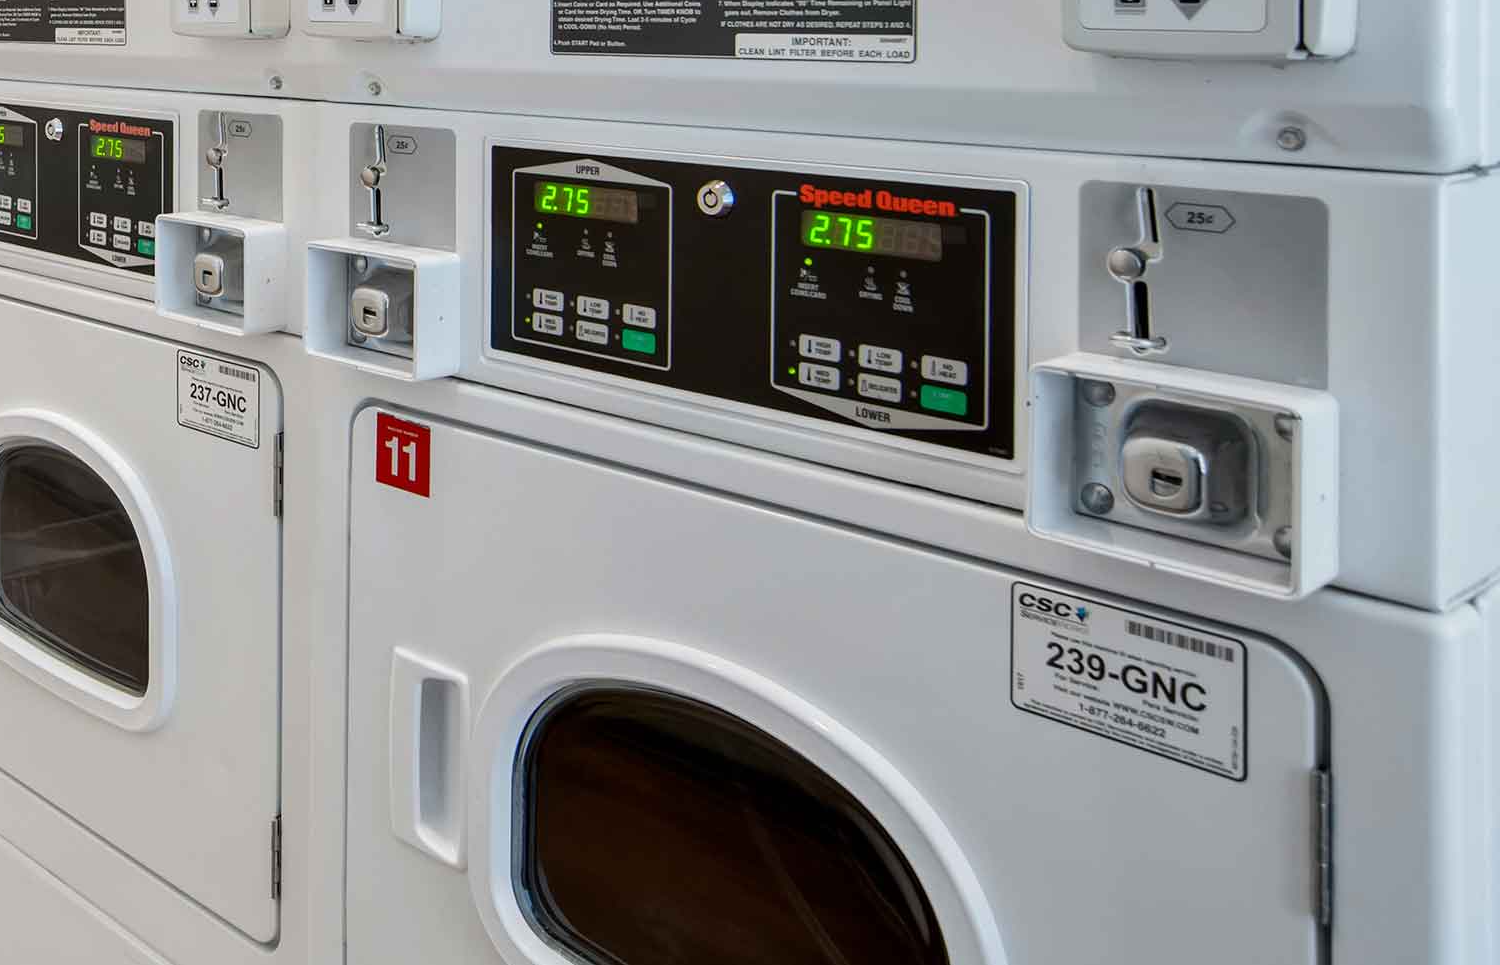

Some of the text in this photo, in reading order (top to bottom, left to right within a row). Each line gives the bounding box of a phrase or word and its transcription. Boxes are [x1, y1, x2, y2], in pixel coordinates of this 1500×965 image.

[792, 37, 851, 46] IMPORTANT:
[739, 48, 764, 56] CLEAN
[768, 48, 786, 56] LINT
[821, 49, 854, 57] BEFORE
[859, 50, 882, 58] EACH
[886, 50, 910, 58] LOAD
[89, 119, 151, 137] Speed Queen
[96, 138, 123, 158] 2.75
[575, 165, 600, 176] UPPER
[541, 185, 589, 214] 2.75
[799, 184, 956, 217] Speed Queen
[809, 214, 873, 249] 2.75
[180, 356, 199, 368] CSC
[190, 382, 247, 413] 237-GNC
[855, 406, 891, 423] LOWER
[385, 436, 417, 482] 11
[1019, 593, 1072, 617] CSC
[1046, 639, 1206, 715] 239-GNC
